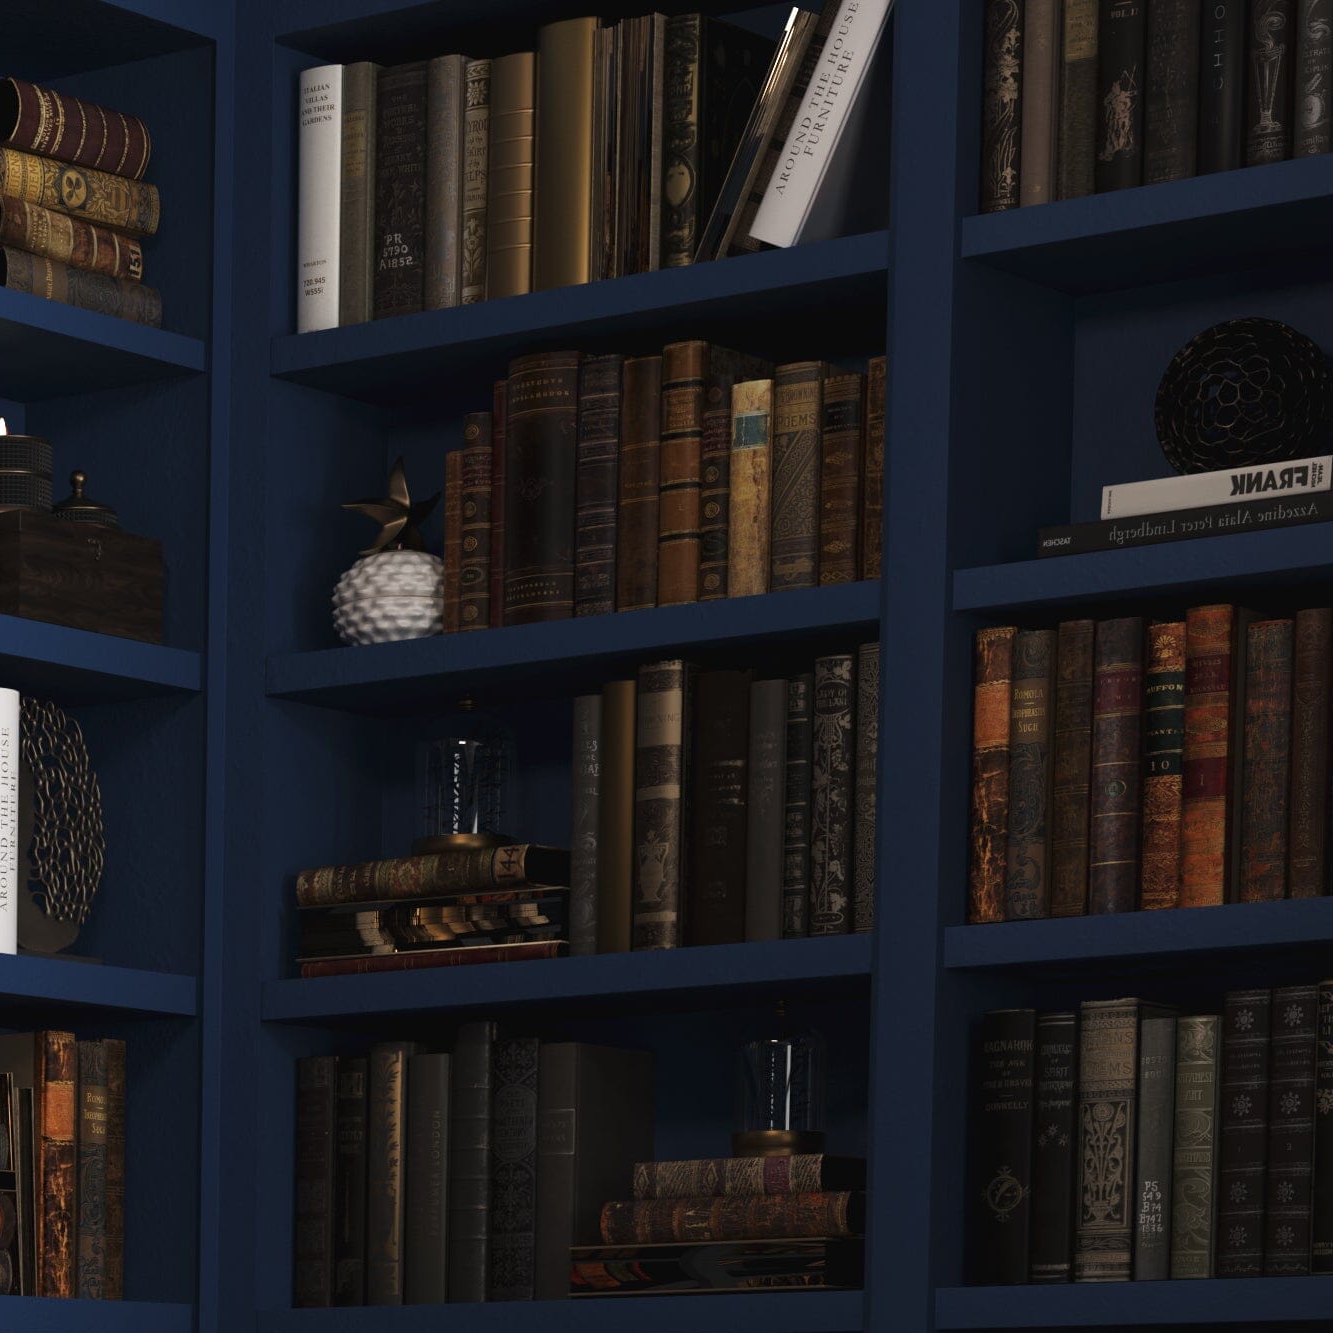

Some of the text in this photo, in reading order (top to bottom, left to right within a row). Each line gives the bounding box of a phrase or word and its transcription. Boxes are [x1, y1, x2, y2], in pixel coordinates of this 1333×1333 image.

[303, 84, 331, 96] ITALIAN
[304, 95, 329, 105] VILLAS
[775, 2, 860, 196] AROUND THE HOUSE
[803, 50, 855, 158] FURNITURE
[314, 103, 336, 113] THEIR
[302, 115, 333, 128] GARDENS
[386, 233, 403, 244] PR
[129, 245, 143, 279] 151
[302, 276, 326, 289] 720.945
[0, 727, 10, 912] AROUND THE HOUSE
[496, 846, 521, 881] 144
